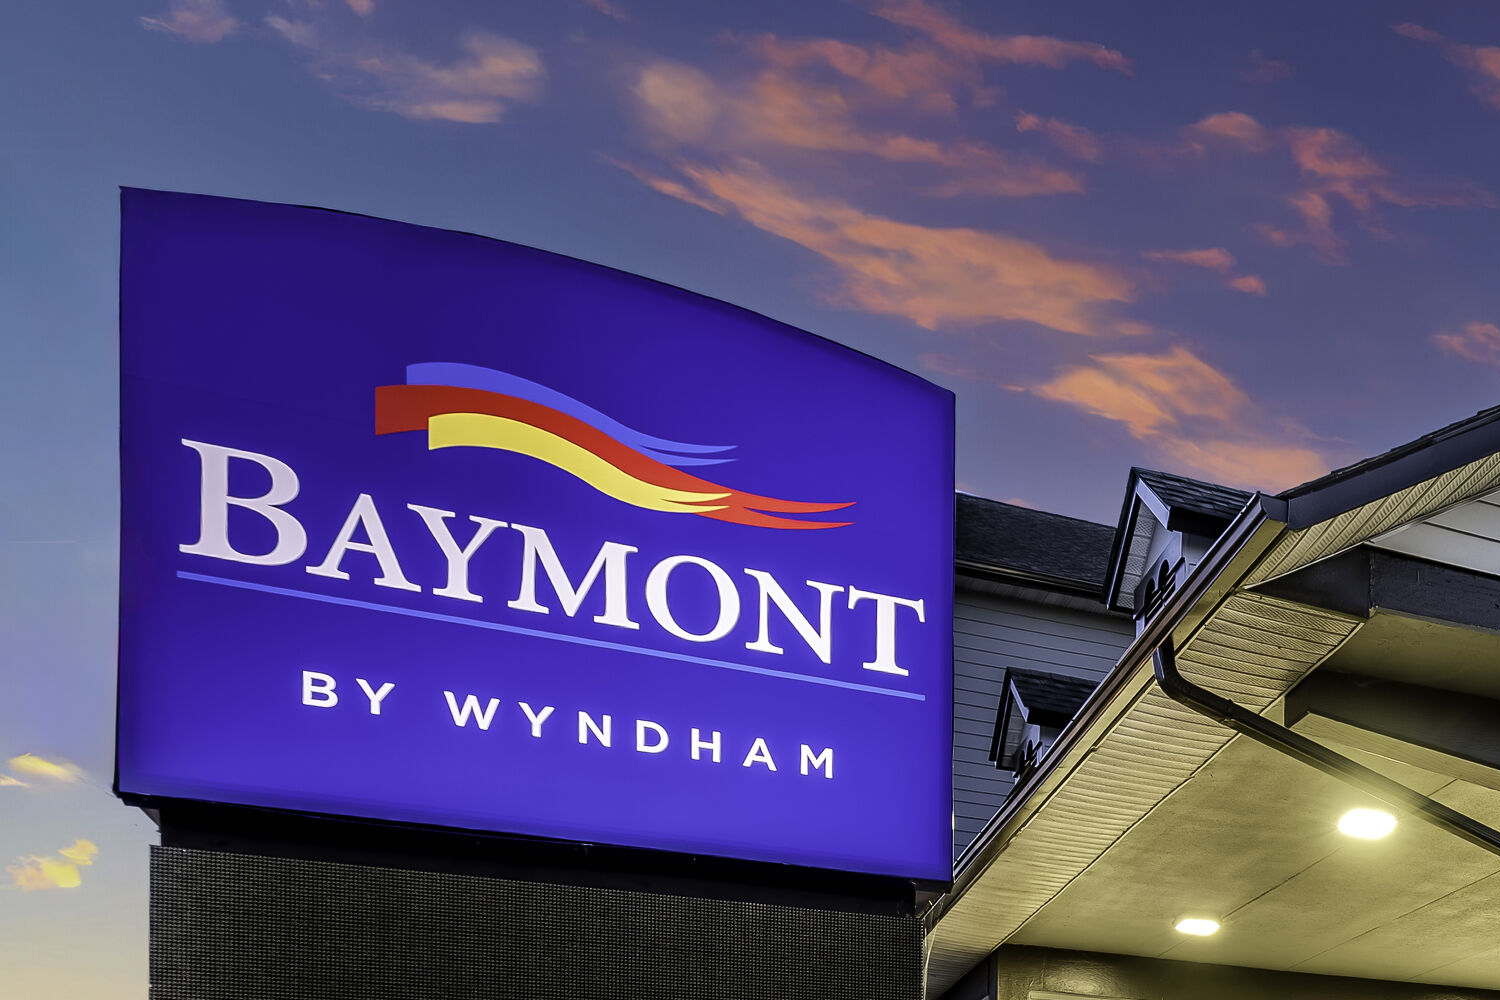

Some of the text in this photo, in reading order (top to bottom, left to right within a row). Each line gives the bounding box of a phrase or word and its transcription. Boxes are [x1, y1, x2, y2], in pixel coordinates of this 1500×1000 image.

[178, 438, 926, 677] BAYMONT
[302, 670, 834, 779] BY WYNDHAM
